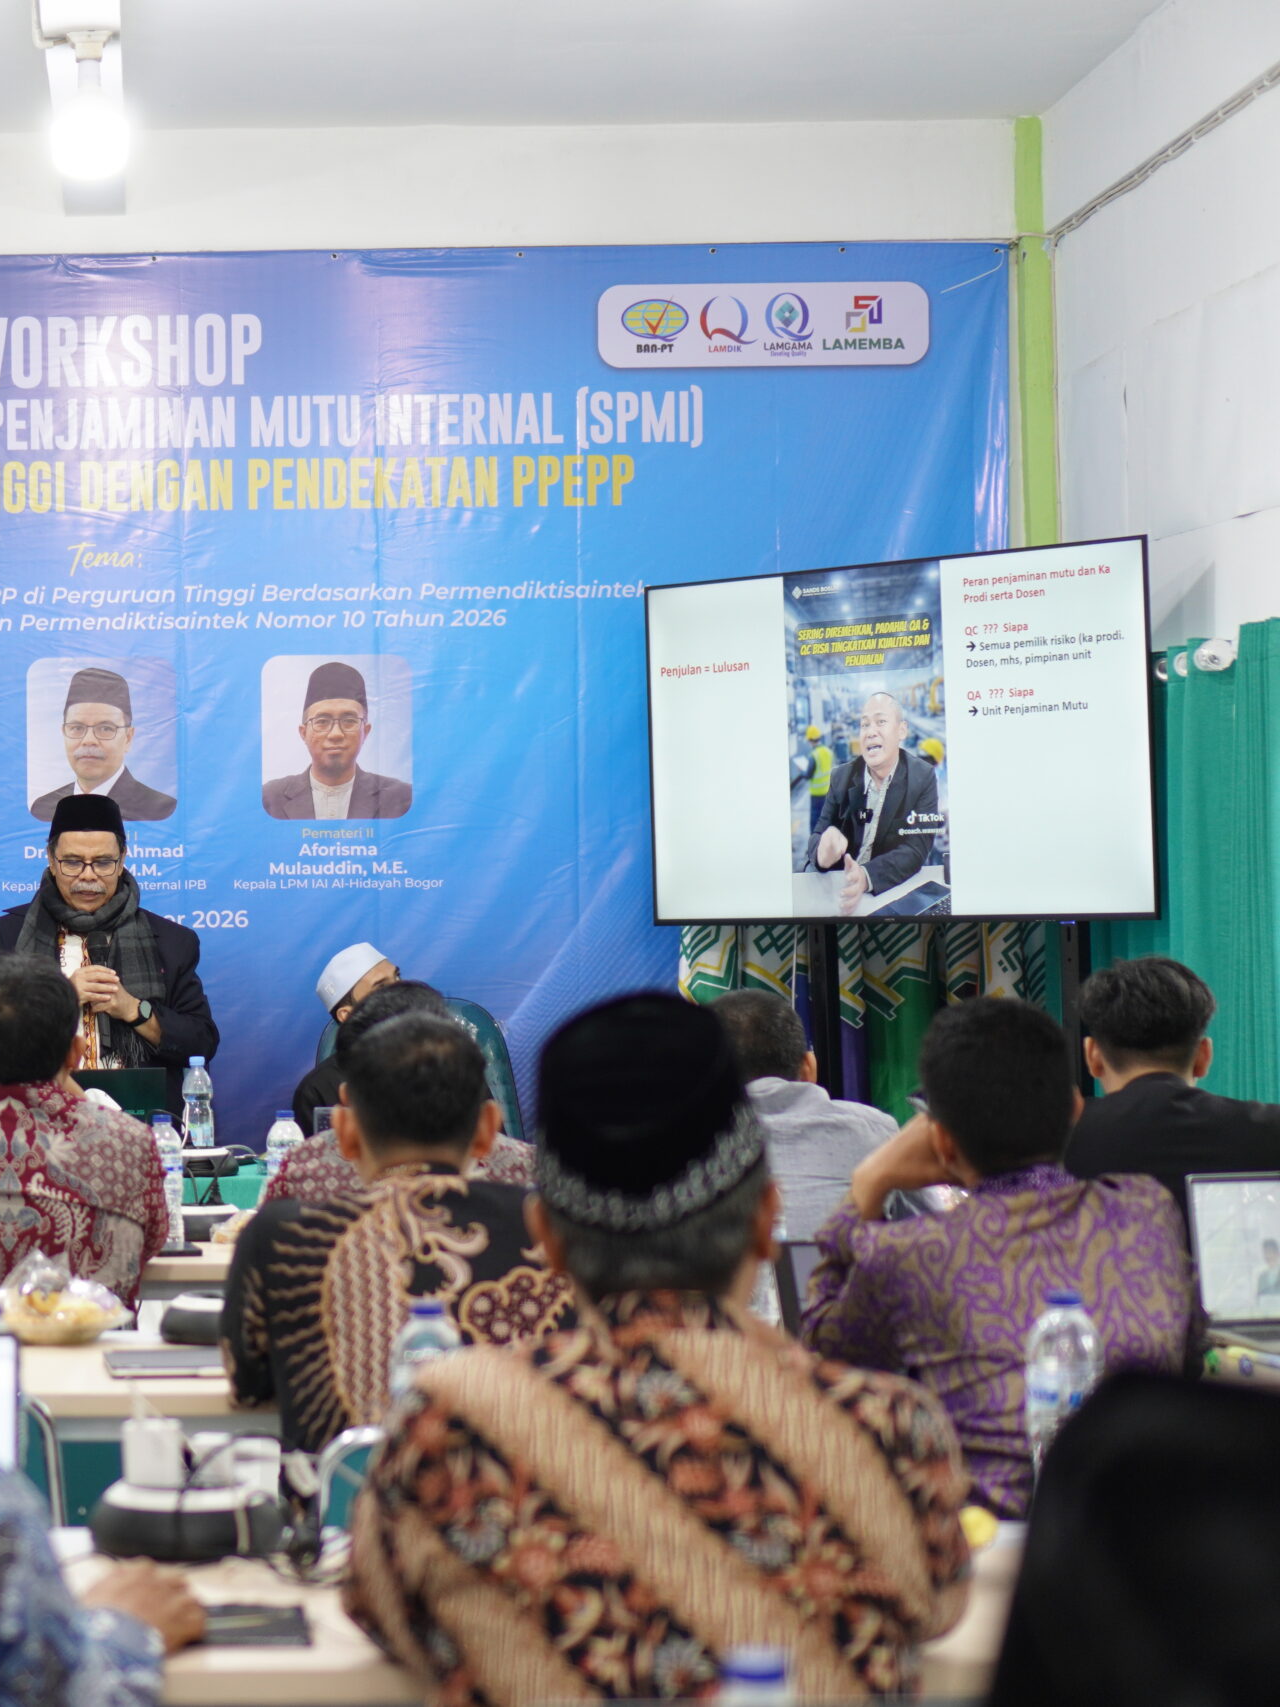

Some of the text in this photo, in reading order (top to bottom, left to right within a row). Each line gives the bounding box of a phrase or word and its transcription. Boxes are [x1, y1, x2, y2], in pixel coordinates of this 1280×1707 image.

[637, 344, 674, 354] BAN-PT
[708, 345, 742, 353] LAMDIK
[764, 341, 813, 351] LAMGAMA
[822, 338, 905, 351] LAMEMBA
[250, 395, 360, 449] MUTU
[376, 392, 564, 447] INTERNAL
[577, 384, 703, 449] (SPMI)
[80, 458, 233, 513] DENGAN
[248, 455, 499, 510] PENDEKATAN
[512, 453, 635, 507] PPEPP
[67, 541, 143, 577] Tema:
[963, 564, 1111, 587] Peran penjaminan mutu dan Ka
[23, 586, 47, 604] di
[52, 587, 176, 608] Perguruan
[183, 584, 257, 607] Tinggi
[262, 583, 412, 602] Berdasarkan
[420, 580, 648, 600] Permendiktisaintek
[963, 588, 1045, 603] Prodi serta Dosen
[19, 612, 249, 632] Permendiktisaintek
[255, 611, 336, 629] Nomor
[342, 611, 366, 628] 10
[373, 609, 445, 628] Tahun
[450, 609, 507, 627] 2026
[798, 618, 930, 641] SERING DIREMEHKAN, PADAHAL QA &
[964, 622, 1029, 636] QC ??? Siapa
[799, 633, 931, 656] QC BISA TINGKATKAN KUALITAS DAN
[979, 640, 1010, 651] Semua
[1013, 637, 1048, 651] pemilik
[1050, 635, 1076, 646] risiko
[1078, 633, 1094, 646] (ka
[844, 653, 885, 667] PENJUALAN
[966, 649, 1091, 668] Dosen, mhs, pimpinan unit
[660, 664, 702, 679] Penjulan
[712, 660, 750, 674] Lulusan
[967, 687, 1034, 701] QA ??? Siapa
[982, 700, 1088, 716] Unit Penjaminan Mutu
[918, 813, 945, 823] TikTok
[301, 828, 363, 839] Pemateri
[298, 843, 378, 857] Aforisma
[269, 861, 408, 877] Mulauddin, M.E.
[184, 880, 207, 890] IPB
[233, 879, 277, 891] Kepala
[280, 879, 308, 889] LPM
[331, 877, 401, 890] Al-Hidayah
[405, 877, 444, 890] Bogor
[192, 910, 249, 929] 2026
